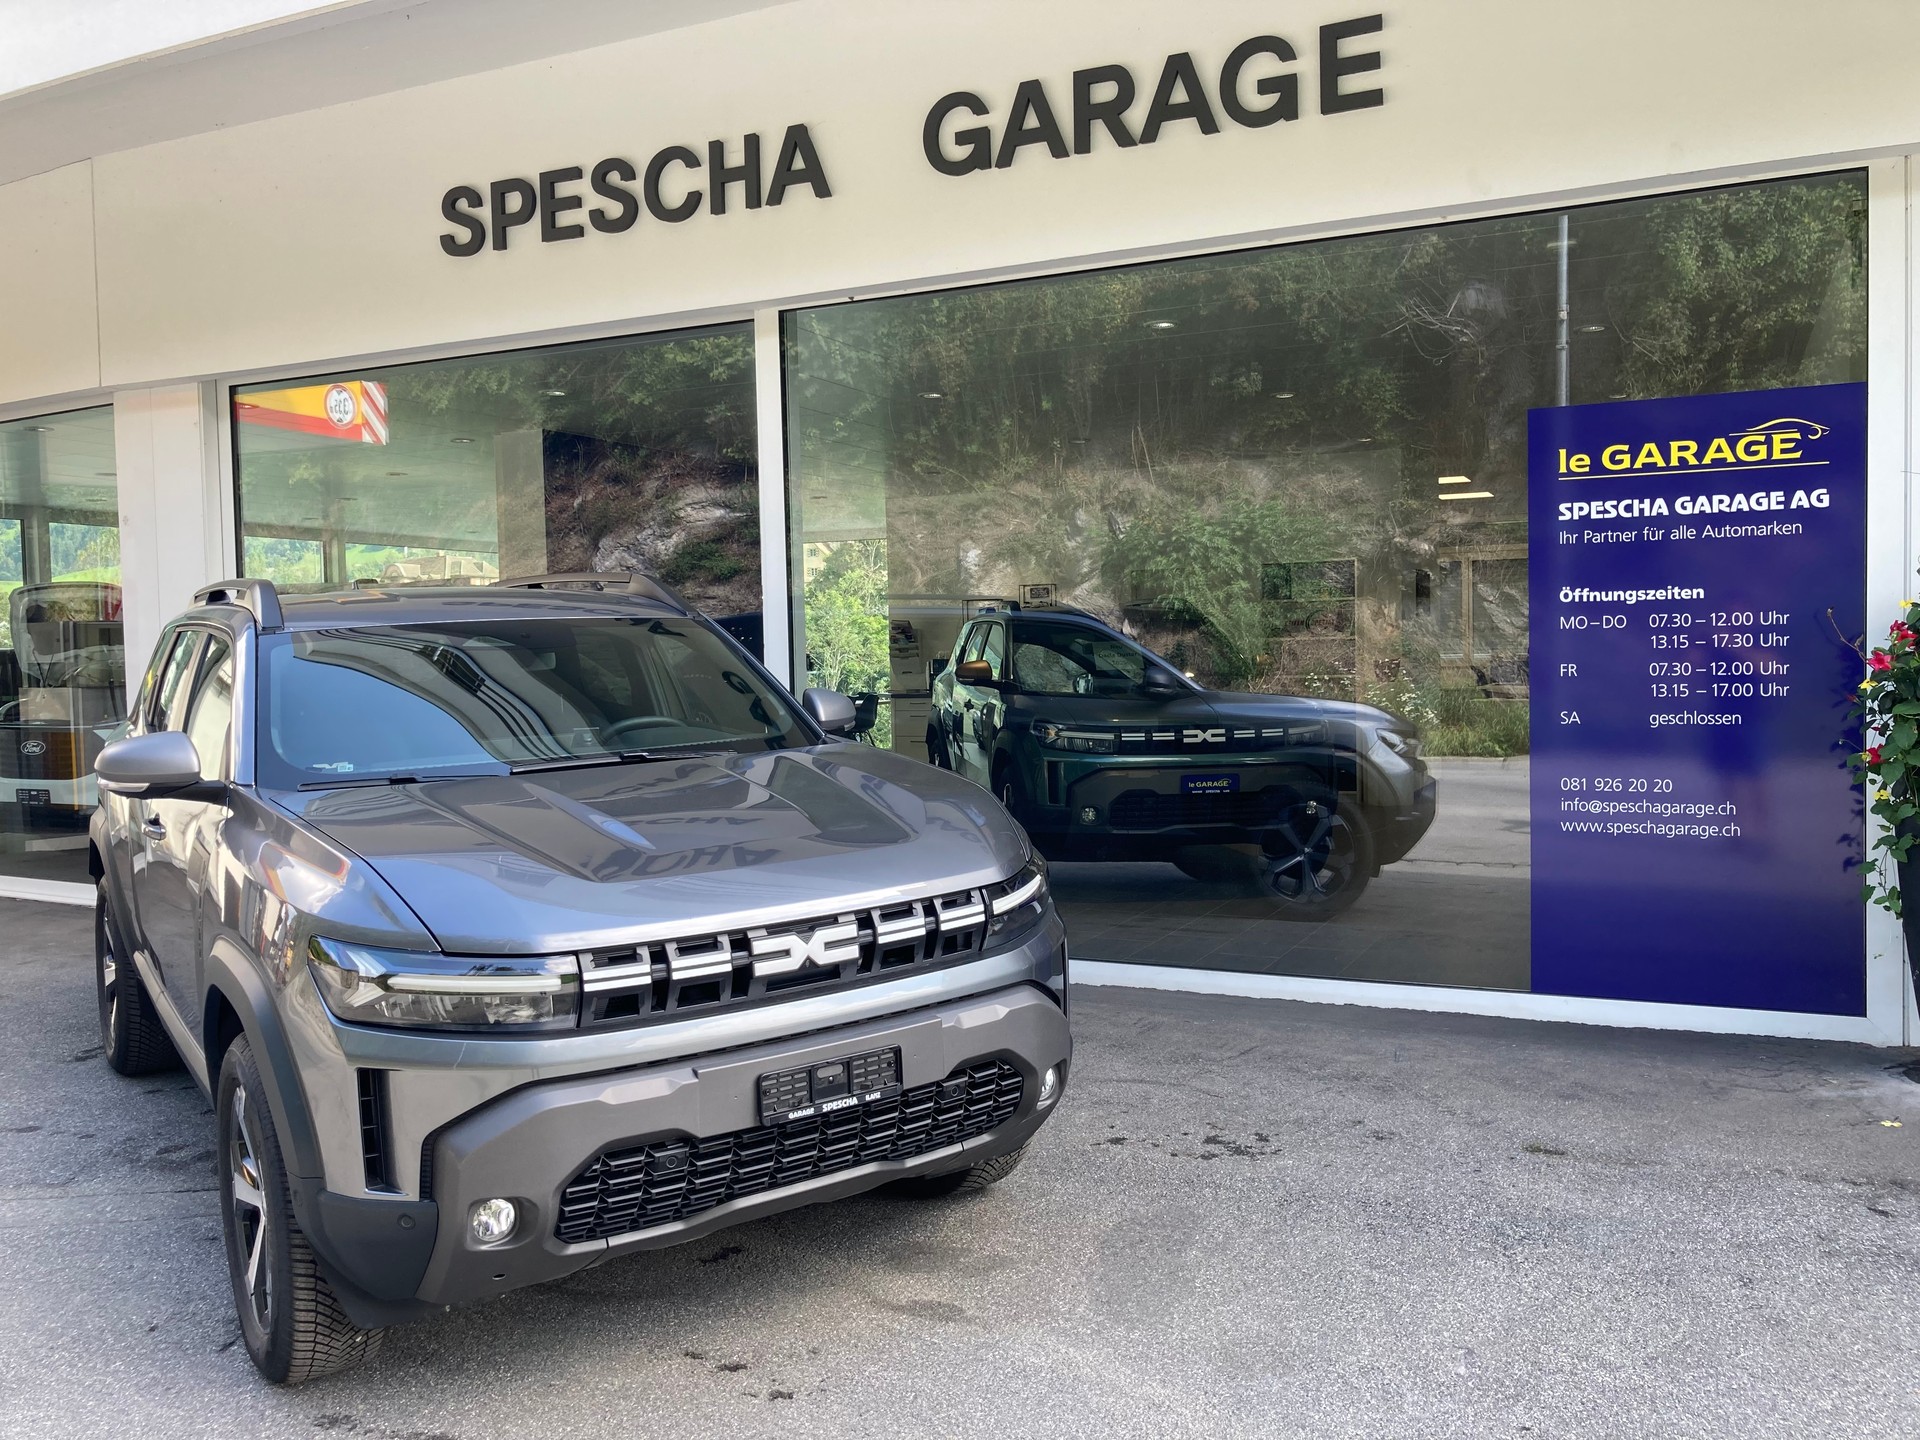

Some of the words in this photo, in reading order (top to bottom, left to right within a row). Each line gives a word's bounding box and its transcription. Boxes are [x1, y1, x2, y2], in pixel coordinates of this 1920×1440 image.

[439, 123, 832, 257] SPESCHA
[922, 13, 1384, 177] GARAGE
[1558, 448, 1591, 474] le
[1601, 432, 1804, 471] GARAGE
[1558, 497, 1669, 521] SPESCHA
[1674, 490, 1786, 515] GARAGE
[1789, 488, 1830, 509] AG
[1559, 530, 1579, 545] Ihr
[1584, 529, 1638, 544] Partner
[1643, 526, 1665, 541] für
[1670, 524, 1697, 540] alle
[1701, 520, 1803, 539] Automarken
[1559, 585, 1705, 605] Öffnungszeiten
[1649, 613, 1692, 628] 07.30
[1710, 611, 1754, 627] 12.00
[1760, 610, 1790, 626] Uhr
[1651, 634, 1690, 649] 13.15
[1712, 633, 1754, 648] 17.30
[1760, 631, 1790, 647] Uhr
[1560, 663, 1578, 677] FR
[1649, 662, 1692, 677] 07.30
[1710, 661, 1754, 676] 12.00
[1760, 660, 1790, 676] Uhr
[1651, 683, 1690, 698] 13.15
[1712, 683, 1754, 697] 17.00
[1760, 682, 1790, 697] Uhr
[1560, 710, 1581, 725] SA
[1649, 710, 1742, 728] geschlossen
[24, 742, 42, 753] Ford
[1195, 780, 1229, 788] GARAGE
[1560, 777, 1587, 791] 081
[1594, 777, 1623, 792] 926
[1628, 778, 1648, 792] 20
[1653, 778, 1673, 793] 20
[1561, 797, 1737, 818] info@speschagarage.ch
[1560, 819, 1741, 840] www.speschagarage.ch
[788, 1108, 815, 1119] GARAGE
[822, 1096, 858, 1113] SPESCHA
